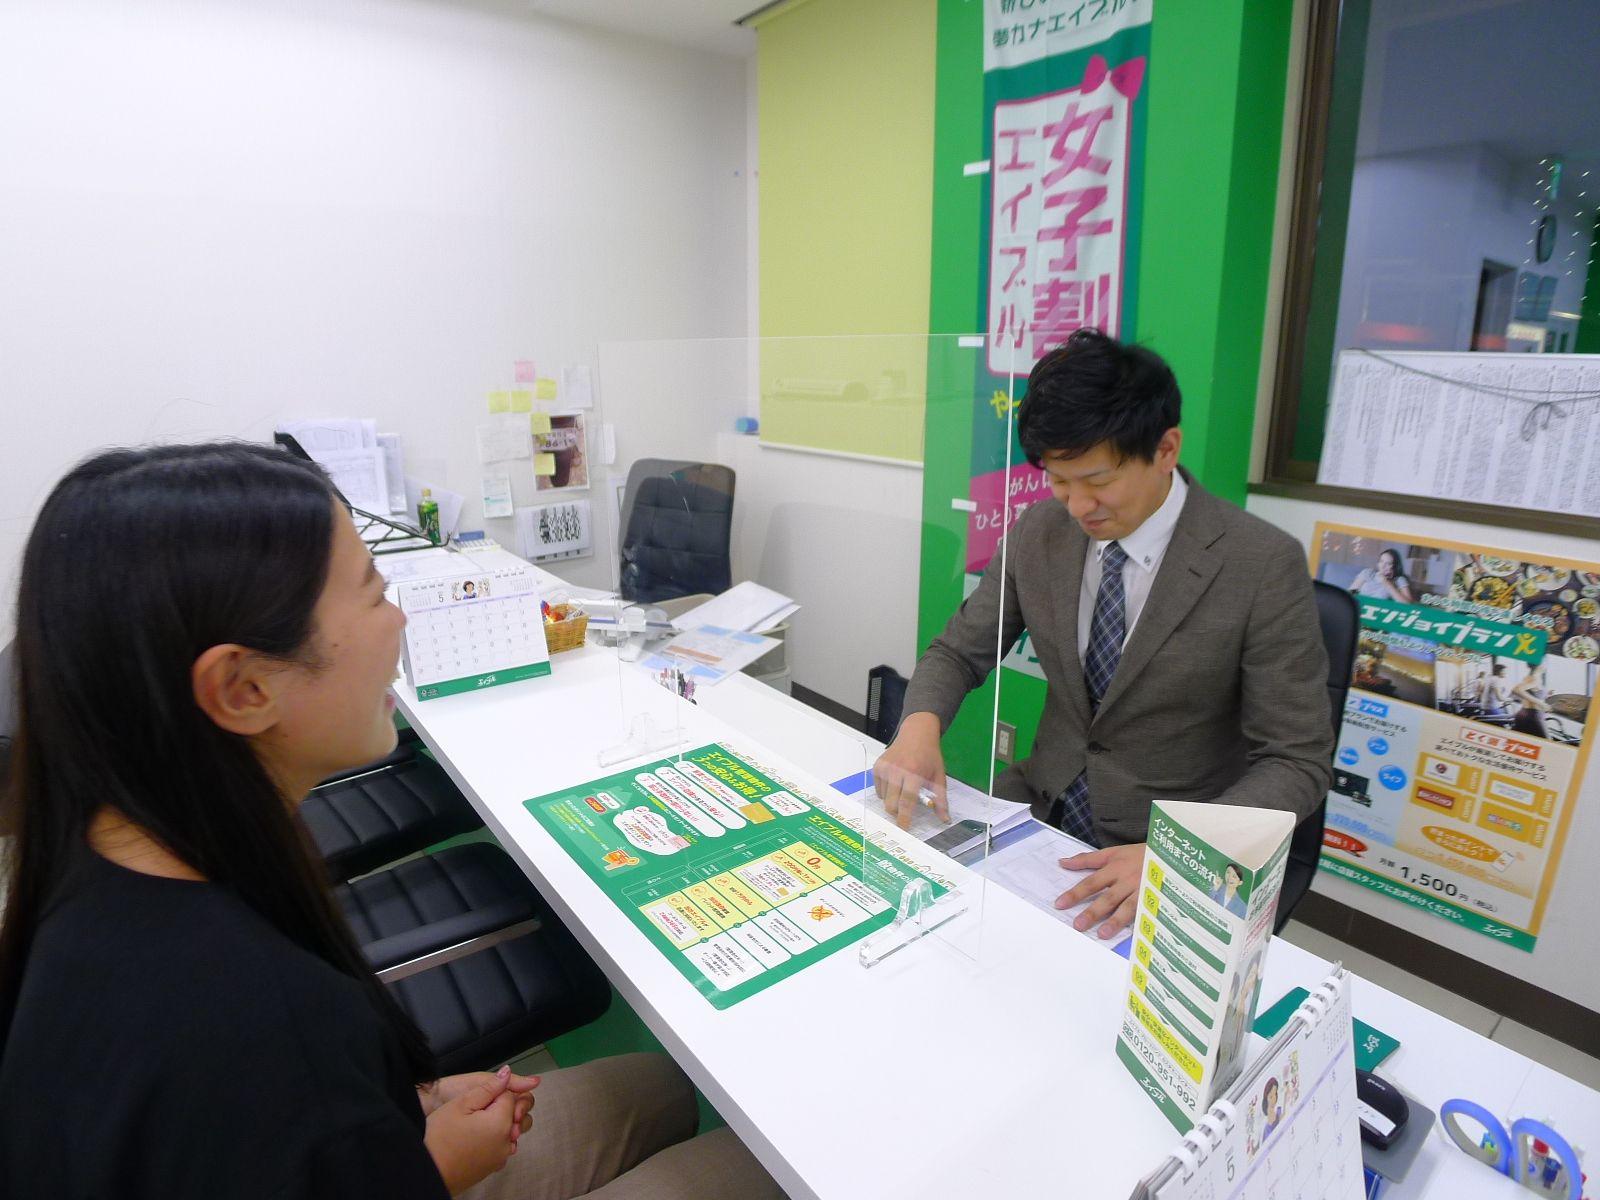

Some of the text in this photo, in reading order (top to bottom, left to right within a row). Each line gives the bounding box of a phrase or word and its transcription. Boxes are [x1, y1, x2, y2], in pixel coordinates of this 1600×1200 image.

[993, 0, 1138, 47] 夢カナエイブル
[996, 128, 1036, 348] エイブル
[1361, 605, 1515, 647] エンジョイプラン
[1151, 828, 1217, 883] ご利用までの流れ
[1154, 817, 1206, 861] インターネット
[1133, 1036, 1196, 1111] 0120-951-992
